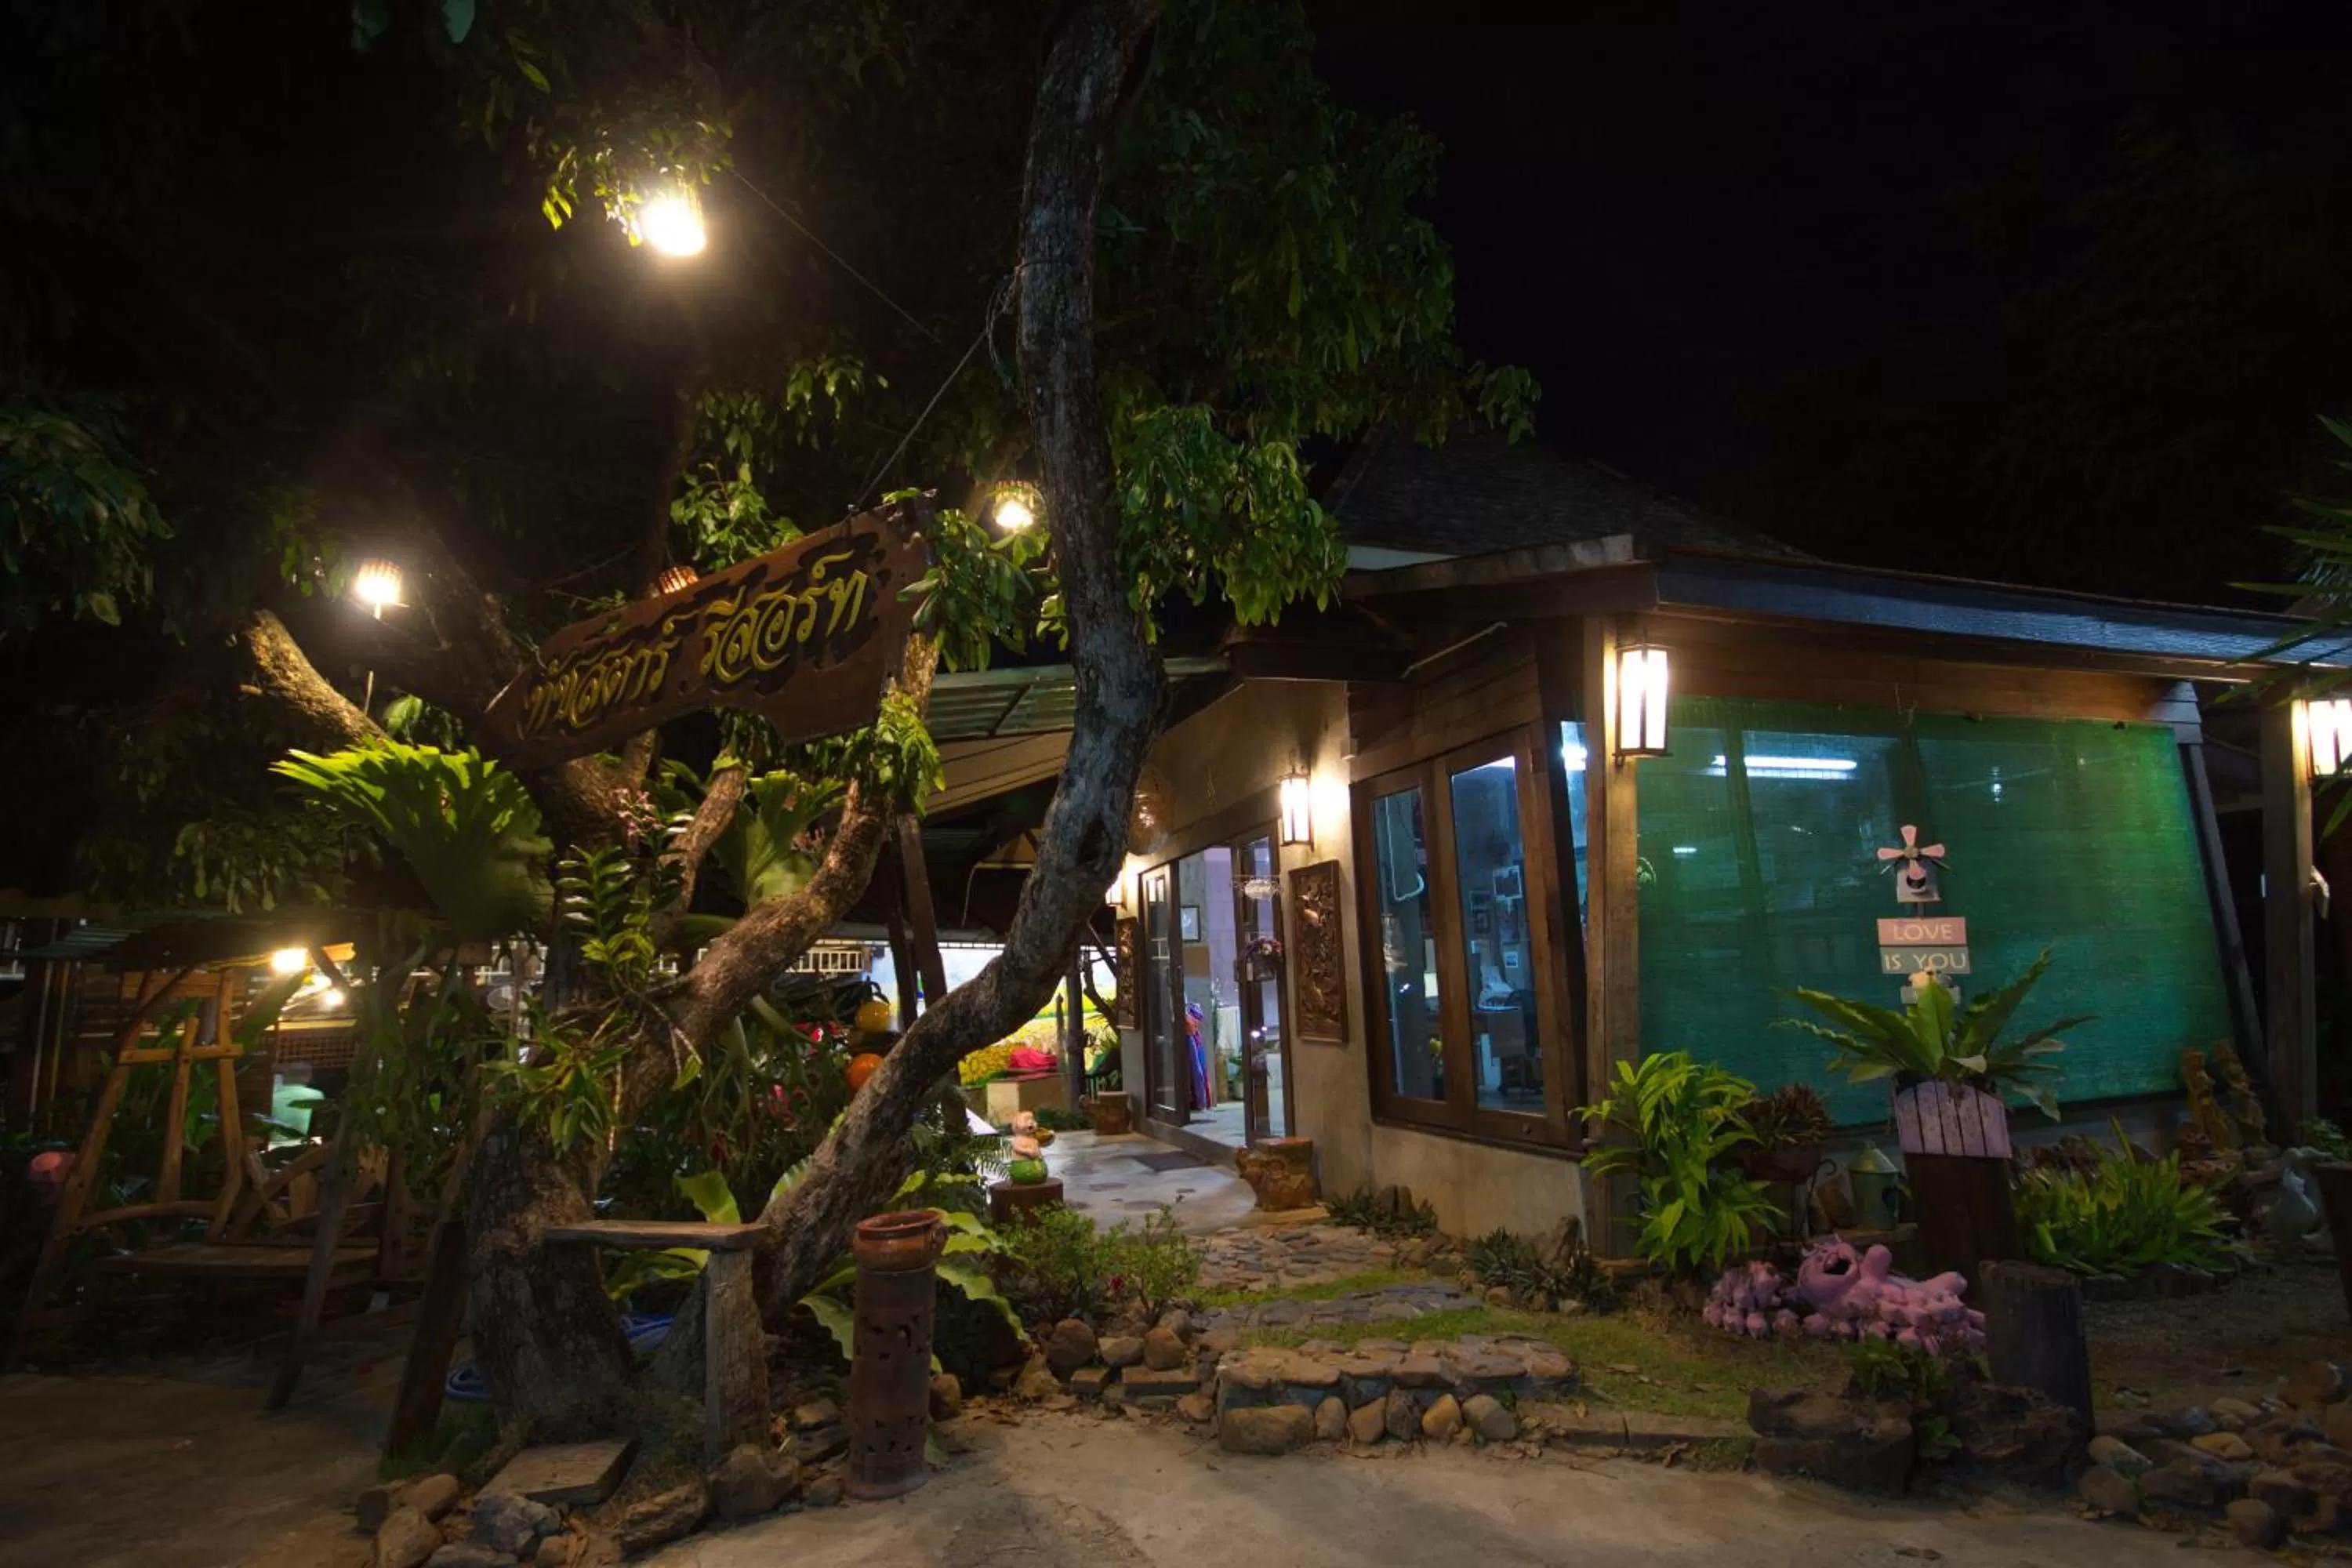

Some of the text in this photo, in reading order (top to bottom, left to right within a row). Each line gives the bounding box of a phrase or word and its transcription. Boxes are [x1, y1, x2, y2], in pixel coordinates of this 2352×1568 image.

[699, 550, 868, 684] รีสอร์ท
[1893, 924, 1954, 941] LOVE
[1884, 952, 1967, 971] IS YOU
